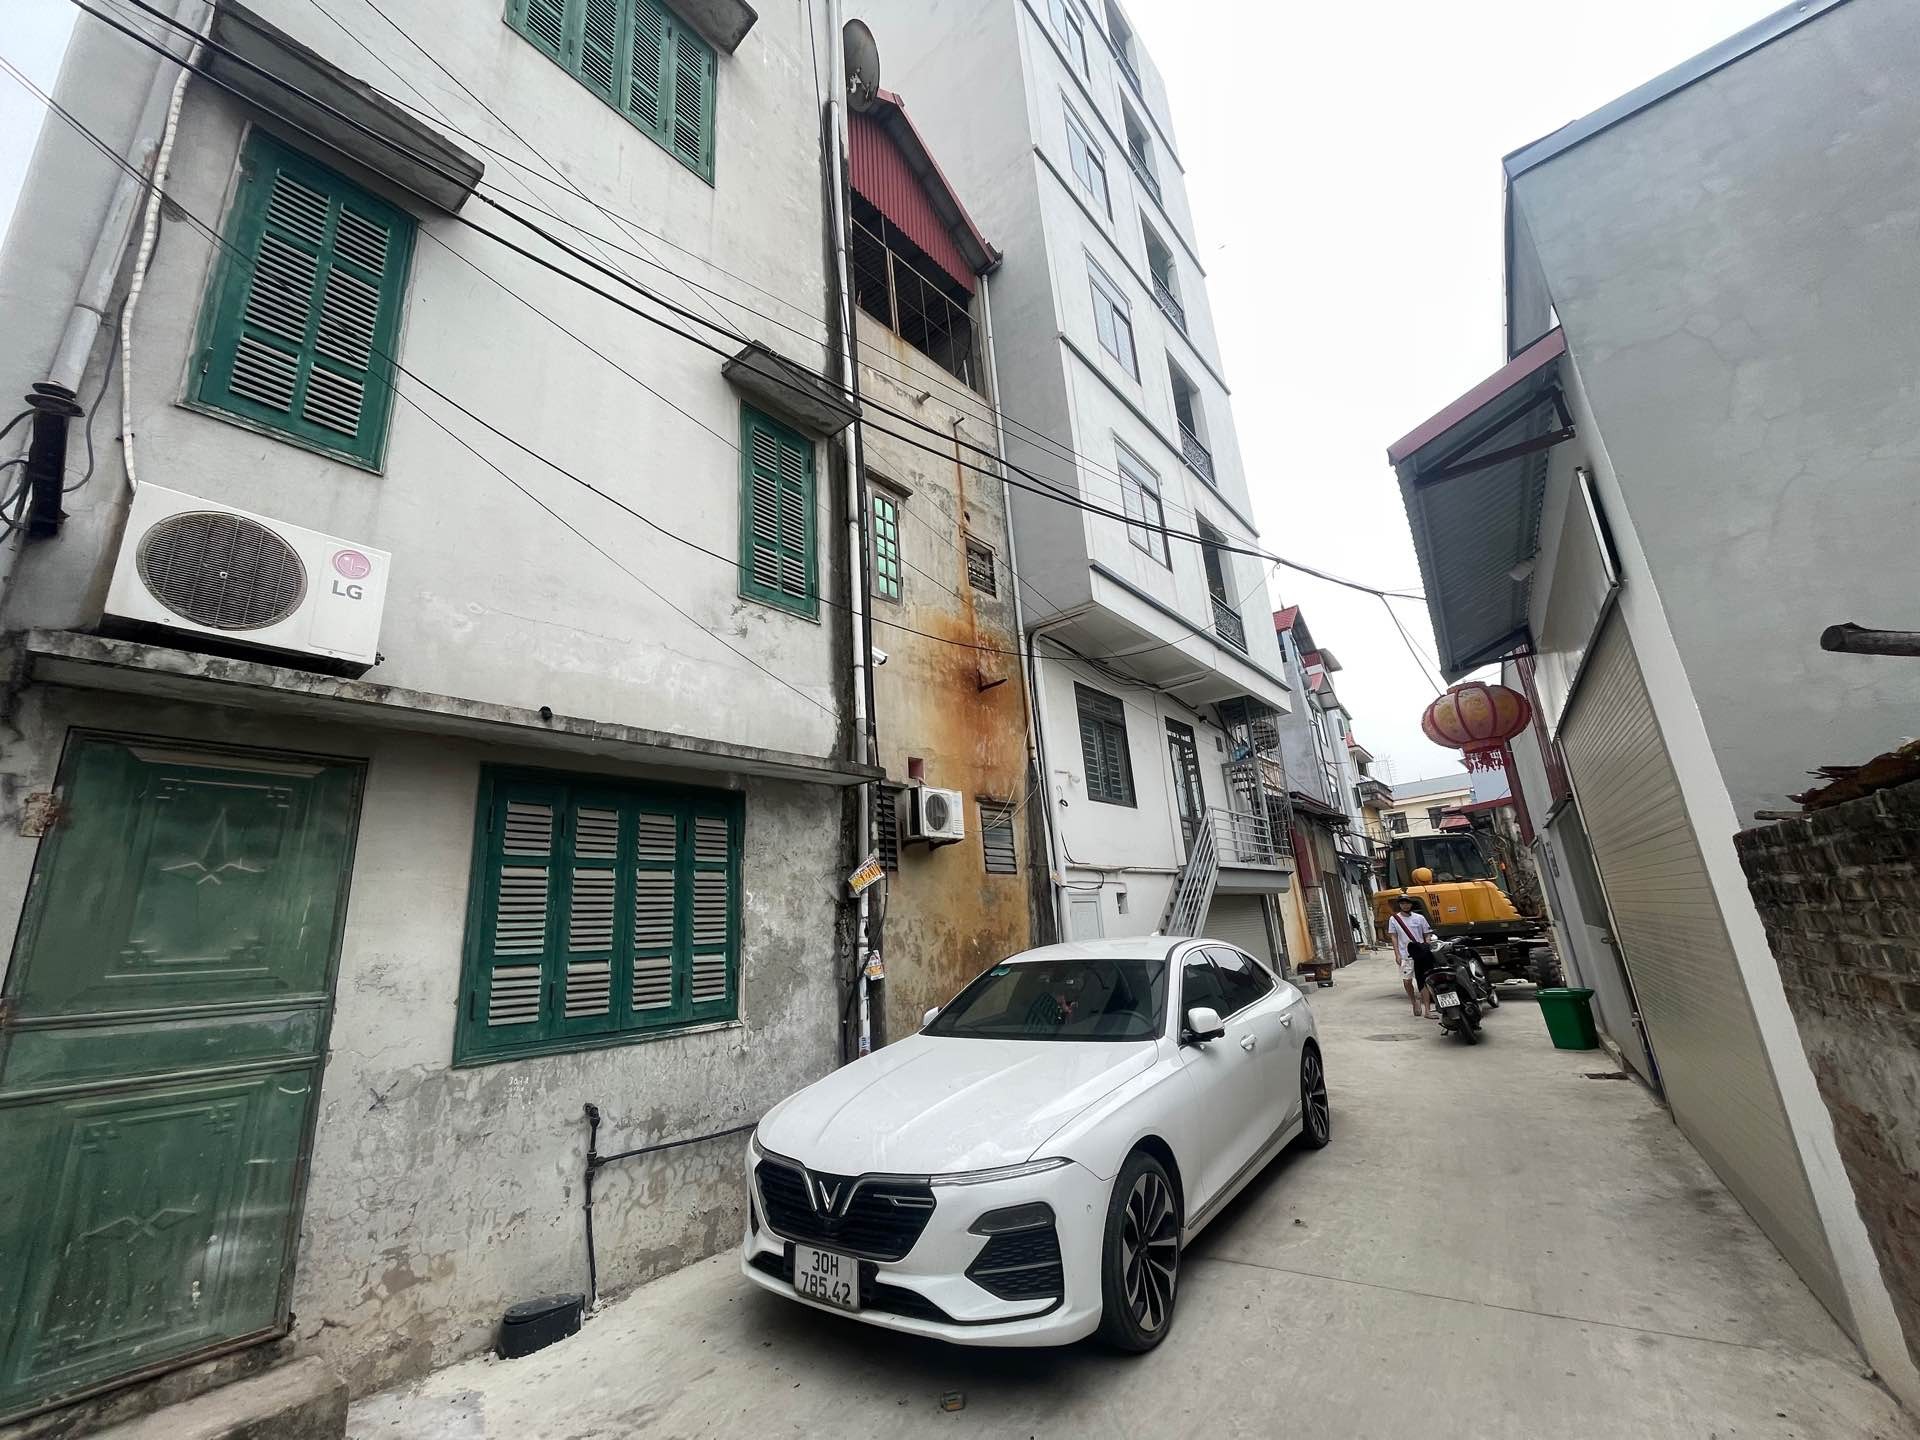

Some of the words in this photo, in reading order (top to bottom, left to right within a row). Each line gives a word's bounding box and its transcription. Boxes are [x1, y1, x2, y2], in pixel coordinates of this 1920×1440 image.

[332, 579, 363, 600] LG
[812, 1251, 839, 1277] 30H
[801, 1271, 851, 1304] 785.42
